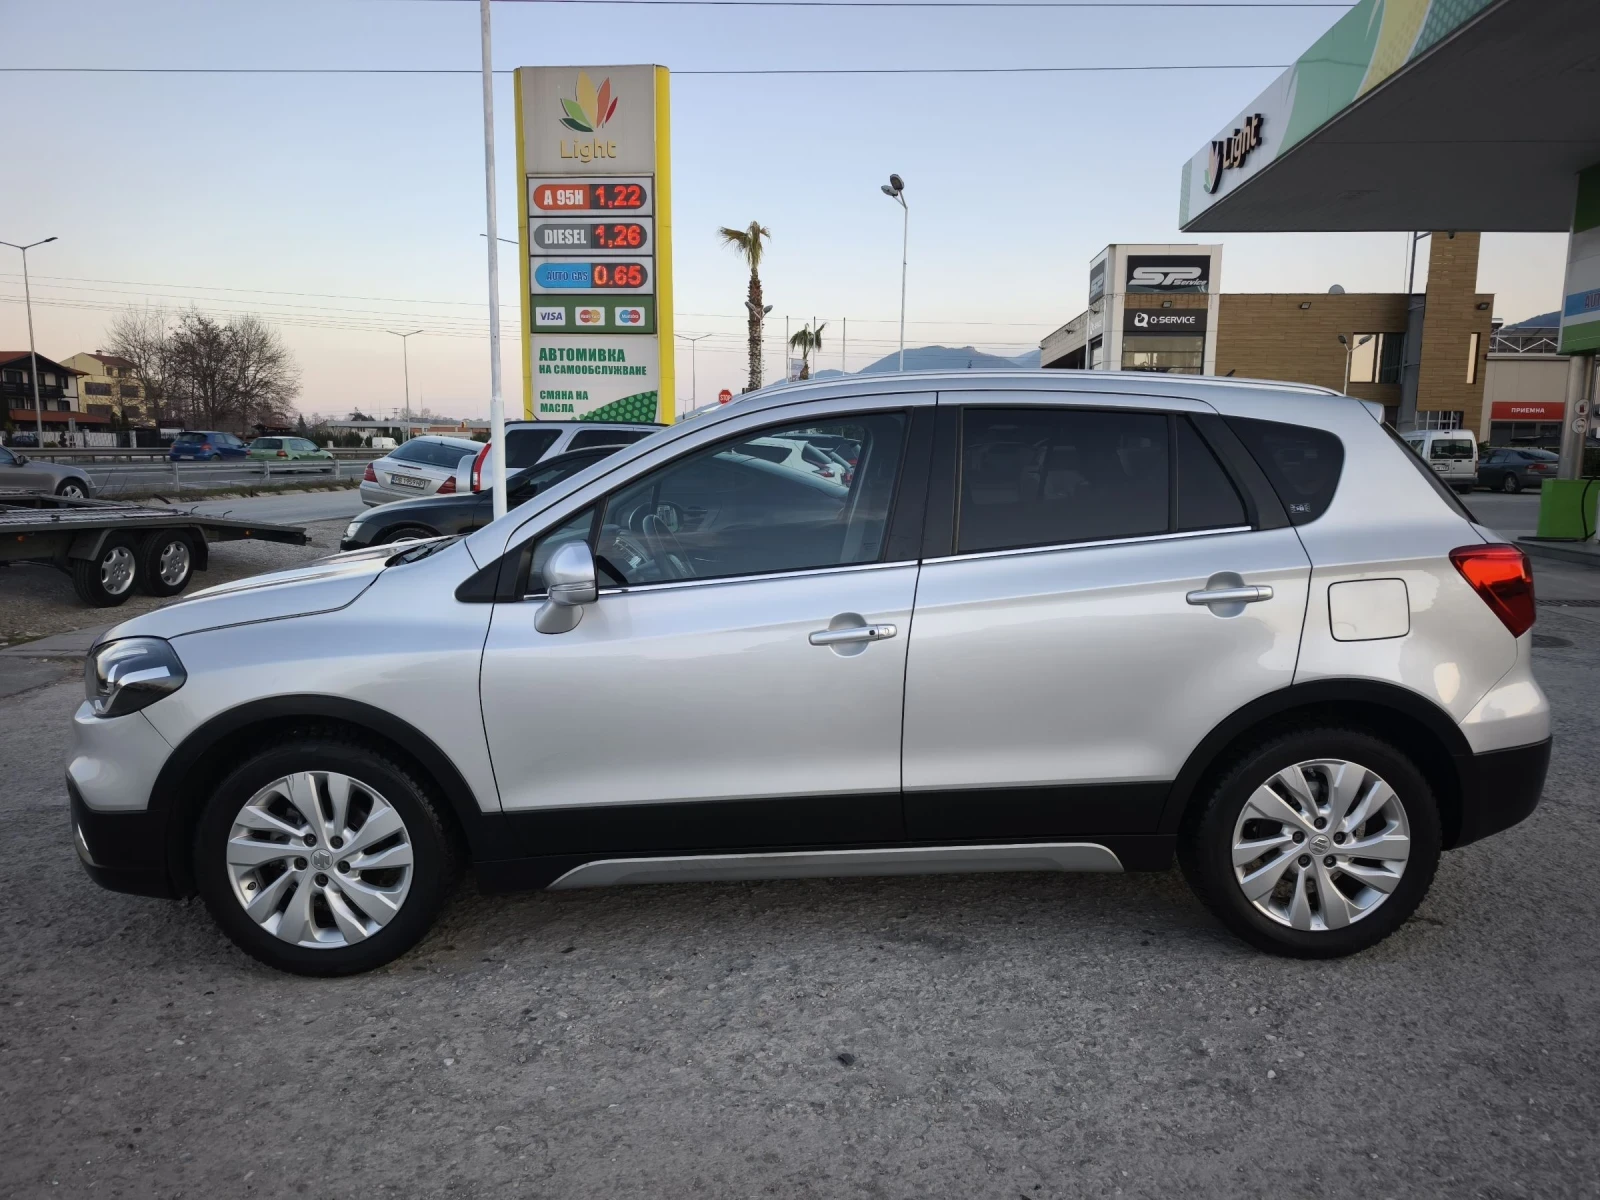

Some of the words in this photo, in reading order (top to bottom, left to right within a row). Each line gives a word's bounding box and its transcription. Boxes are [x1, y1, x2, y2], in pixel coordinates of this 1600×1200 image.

[1223, 113, 1264, 169] Light
[560, 139, 616, 163] Light
[544, 229, 587, 245] DIESEL
[546, 271, 569, 281] AUTO
[571, 271, 588, 281] GAS
[1128, 266, 1202, 286] SP
[540, 312, 563, 321] VISA
[538, 347, 626, 363] АВТОМИВКА
[538, 365, 552, 374] НА
[553, 365, 647, 376] САМООБСЛУЖВАНЕ
[539, 390, 574, 400] СМЯНА
[575, 391, 589, 400] НА
[720, 394, 731, 402] STOP
[540, 403, 574, 413] МАСЛА
